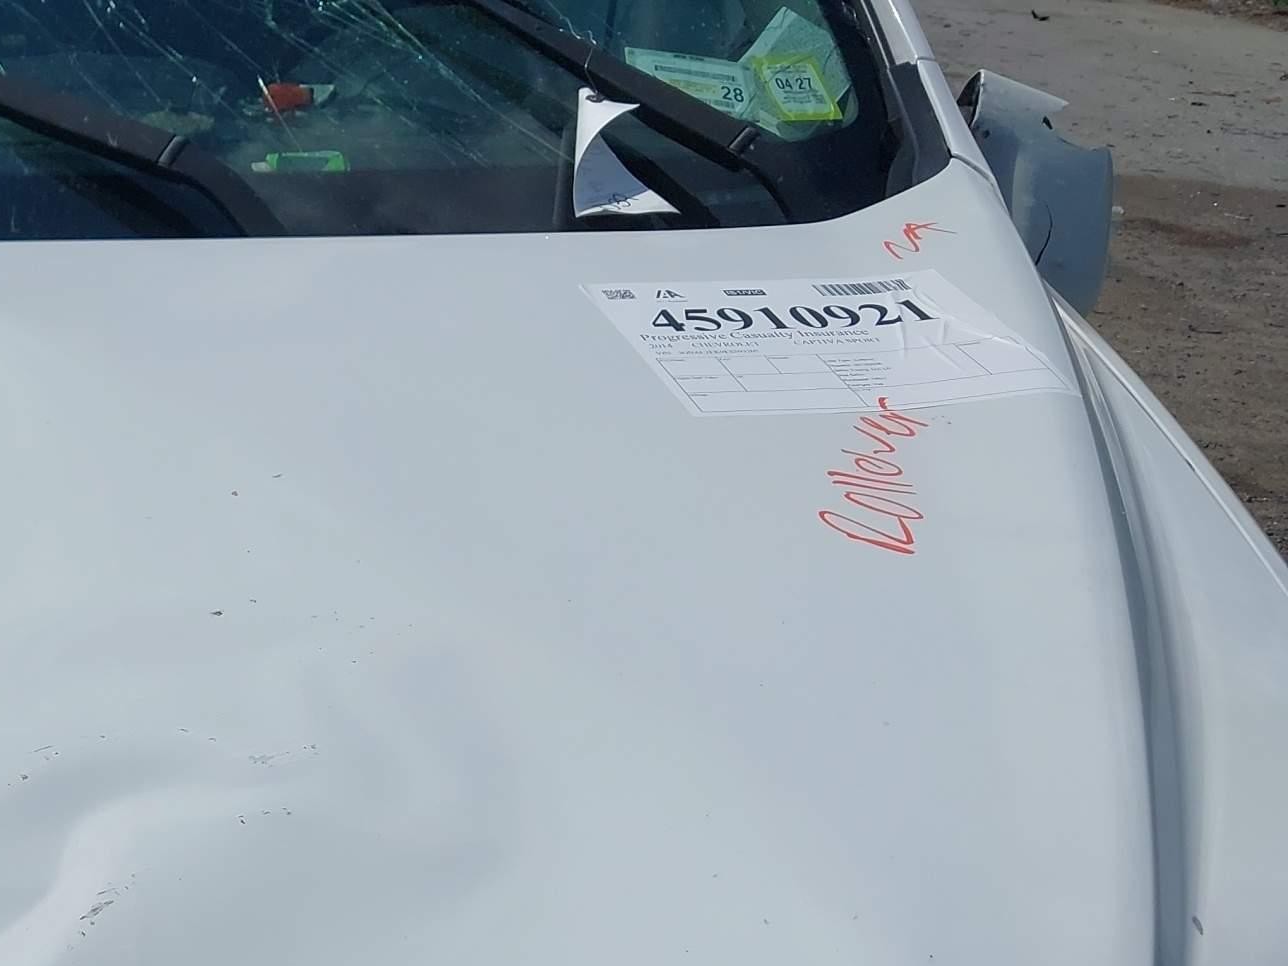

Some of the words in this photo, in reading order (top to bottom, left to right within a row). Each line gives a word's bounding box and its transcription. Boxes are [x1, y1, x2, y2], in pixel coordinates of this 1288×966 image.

[775, 77, 793, 90] 04
[795, 77, 813, 90] 27
[721, 86, 745, 103] 28
[651, 299, 940, 332] 45910921
[640, 332, 727, 343] Progressive
[729, 330, 794, 341] Casualty
[798, 328, 870, 338] Insurance
